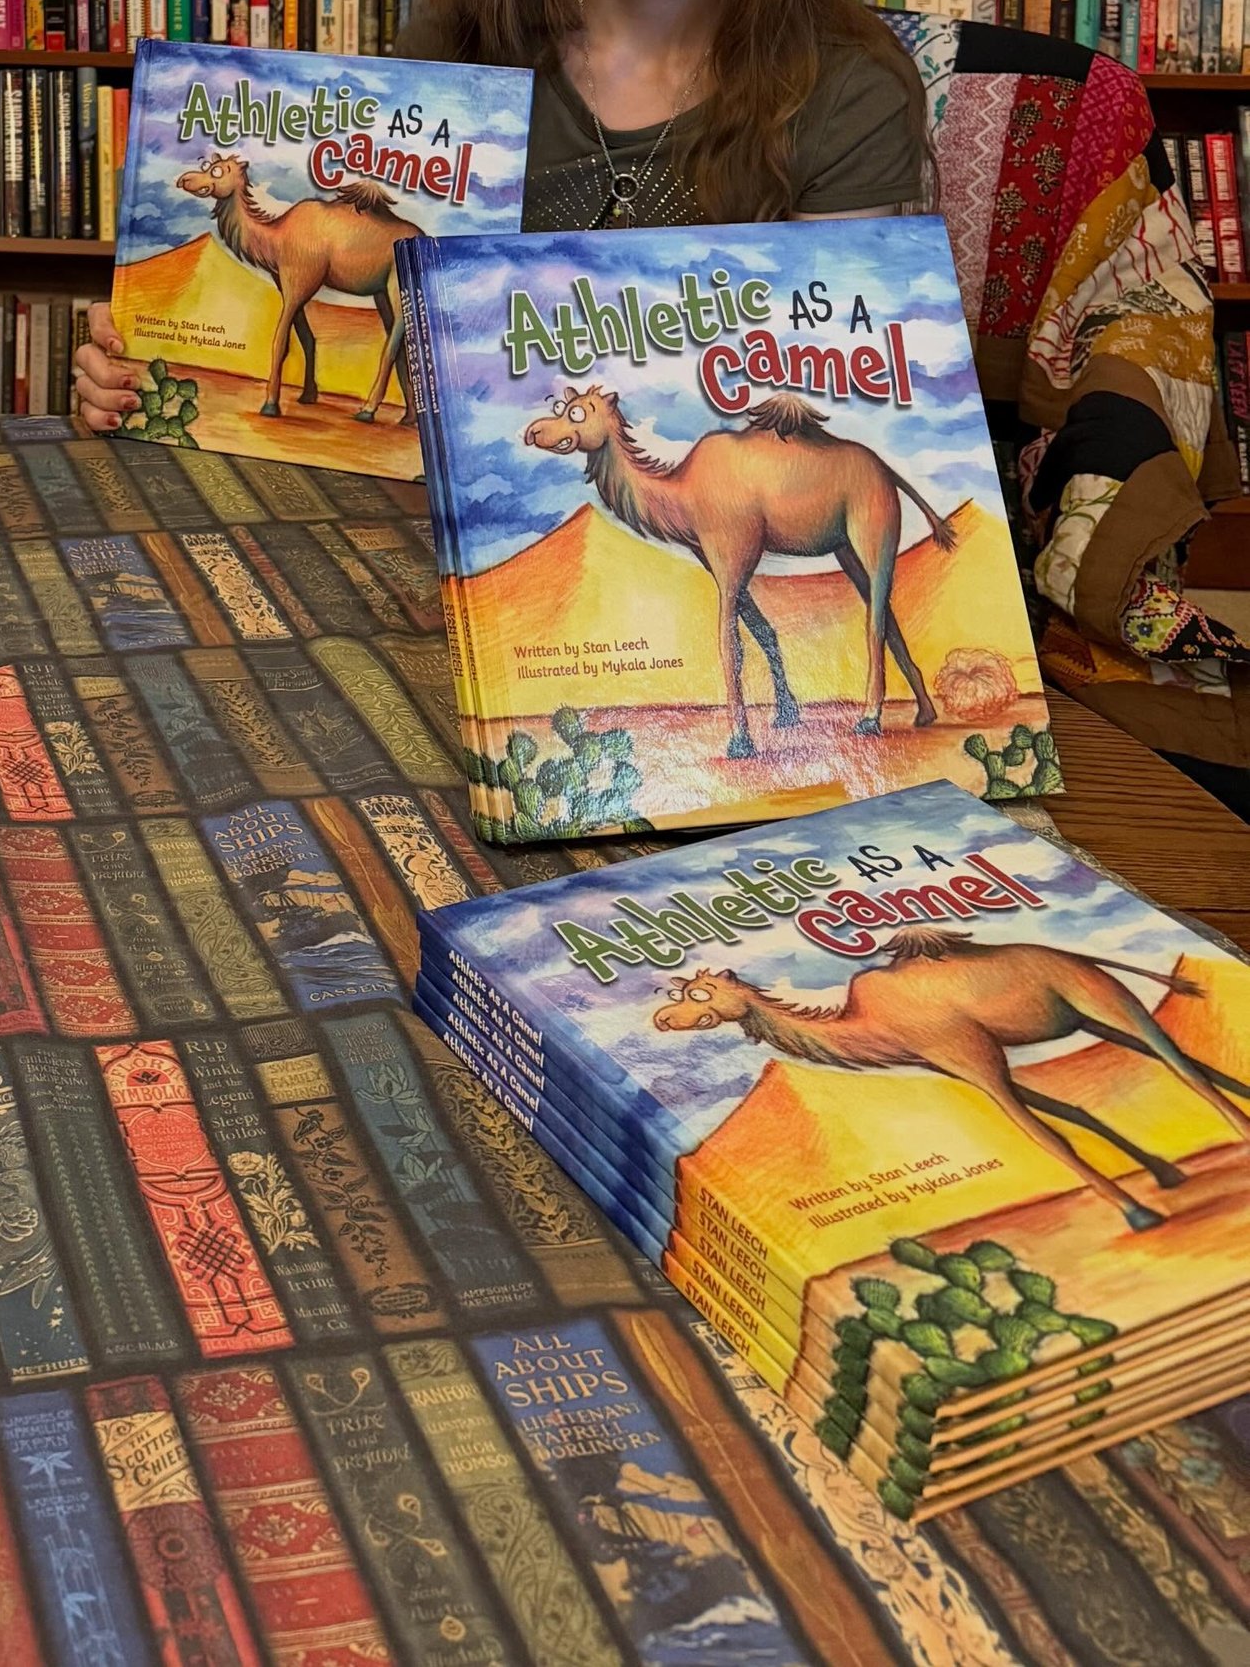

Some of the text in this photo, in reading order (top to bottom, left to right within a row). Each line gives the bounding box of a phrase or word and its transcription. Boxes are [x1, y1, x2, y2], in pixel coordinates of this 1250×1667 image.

[179, 78, 450, 149] Athletic AS A
[310, 131, 475, 204] Camel
[134, 327, 246, 350] Illustrated by Mykala Jones
[136, 314, 226, 334] Written by Stan Leech
[503, 267, 872, 377] Athletic AS A
[699, 322, 914, 415] Camel
[514, 637, 650, 659] Written by Stan Leech
[517, 655, 684, 681] Illustrated by Mykala Jones
[551, 844, 955, 987] Athletic AS A
[795, 850, 1050, 958] Camel
[449, 950, 543, 1046] Athletic As A Camel
[788, 1151, 949, 1213] Written by Stan Leech
[809, 1156, 1004, 1230] Illustrated by Mykala Jones
[698, 1187, 768, 1261] STAN LEECH
[494, 1348, 606, 1380] ABOUT
[511, 1334, 571, 1354] ALL
[505, 1370, 630, 1408] SHIPS
